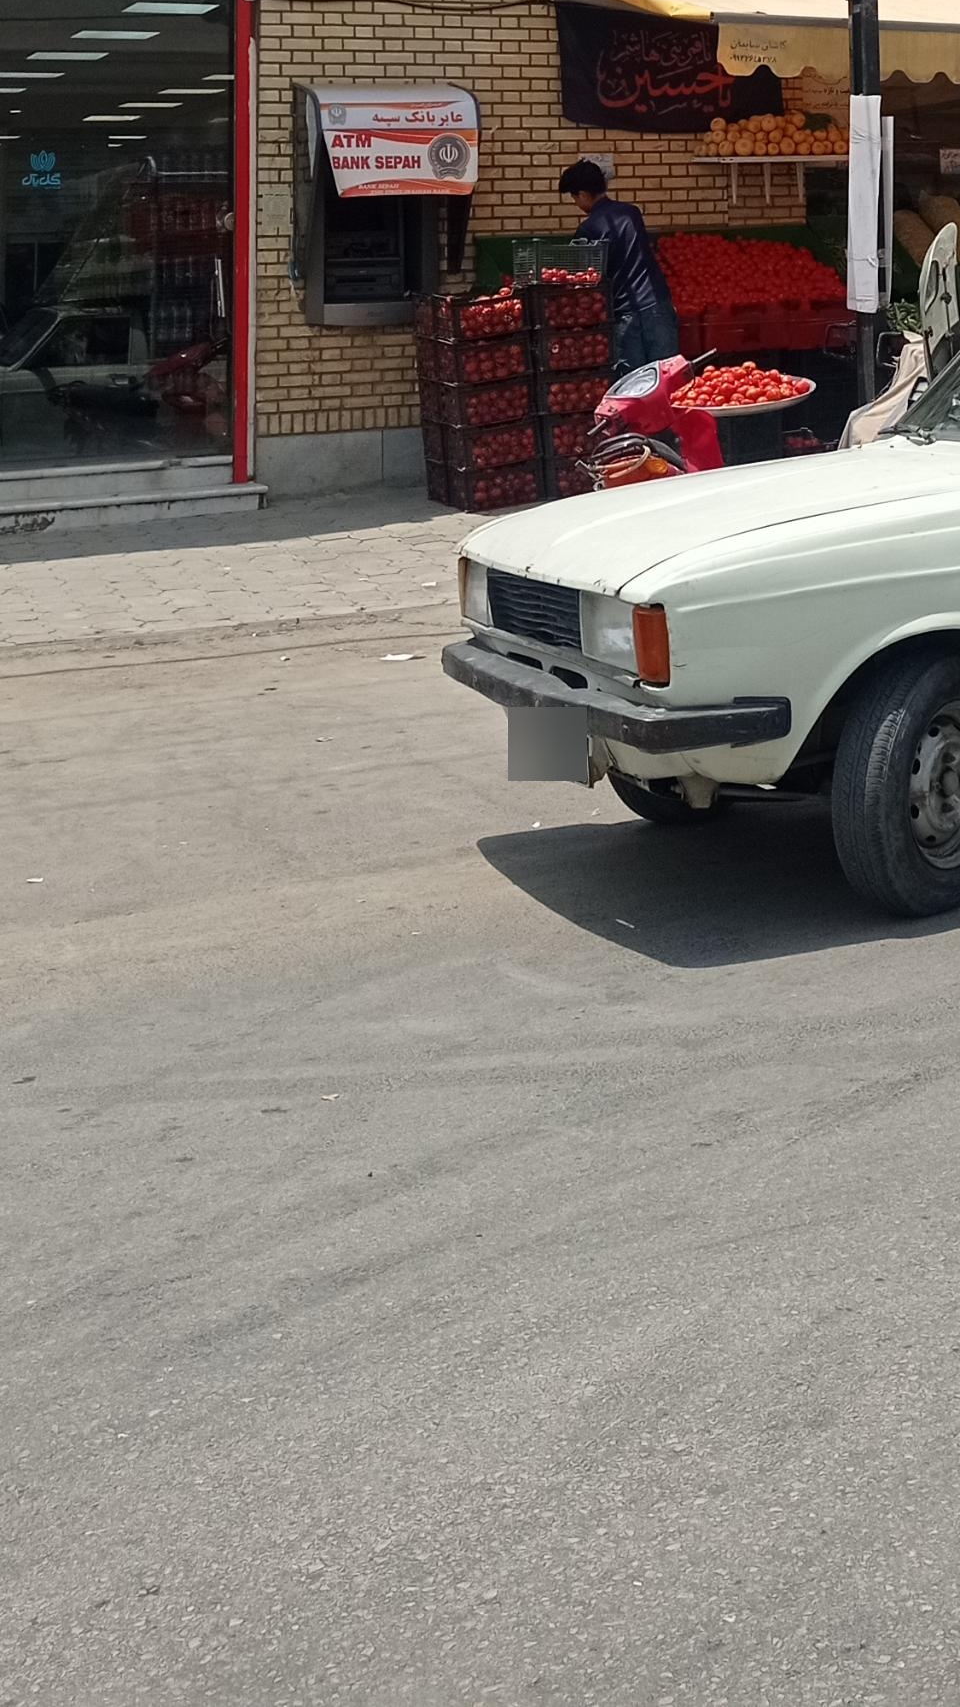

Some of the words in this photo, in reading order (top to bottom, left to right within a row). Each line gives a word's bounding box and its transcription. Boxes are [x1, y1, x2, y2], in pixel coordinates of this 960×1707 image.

[372, 115, 400, 127] سپه
[404, 110, 435, 126] بانک
[438, 111, 464, 126] عابر
[331, 134, 373, 149] ATM
[332, 155, 370, 170] BANK
[375, 155, 421, 170] SEPAH
